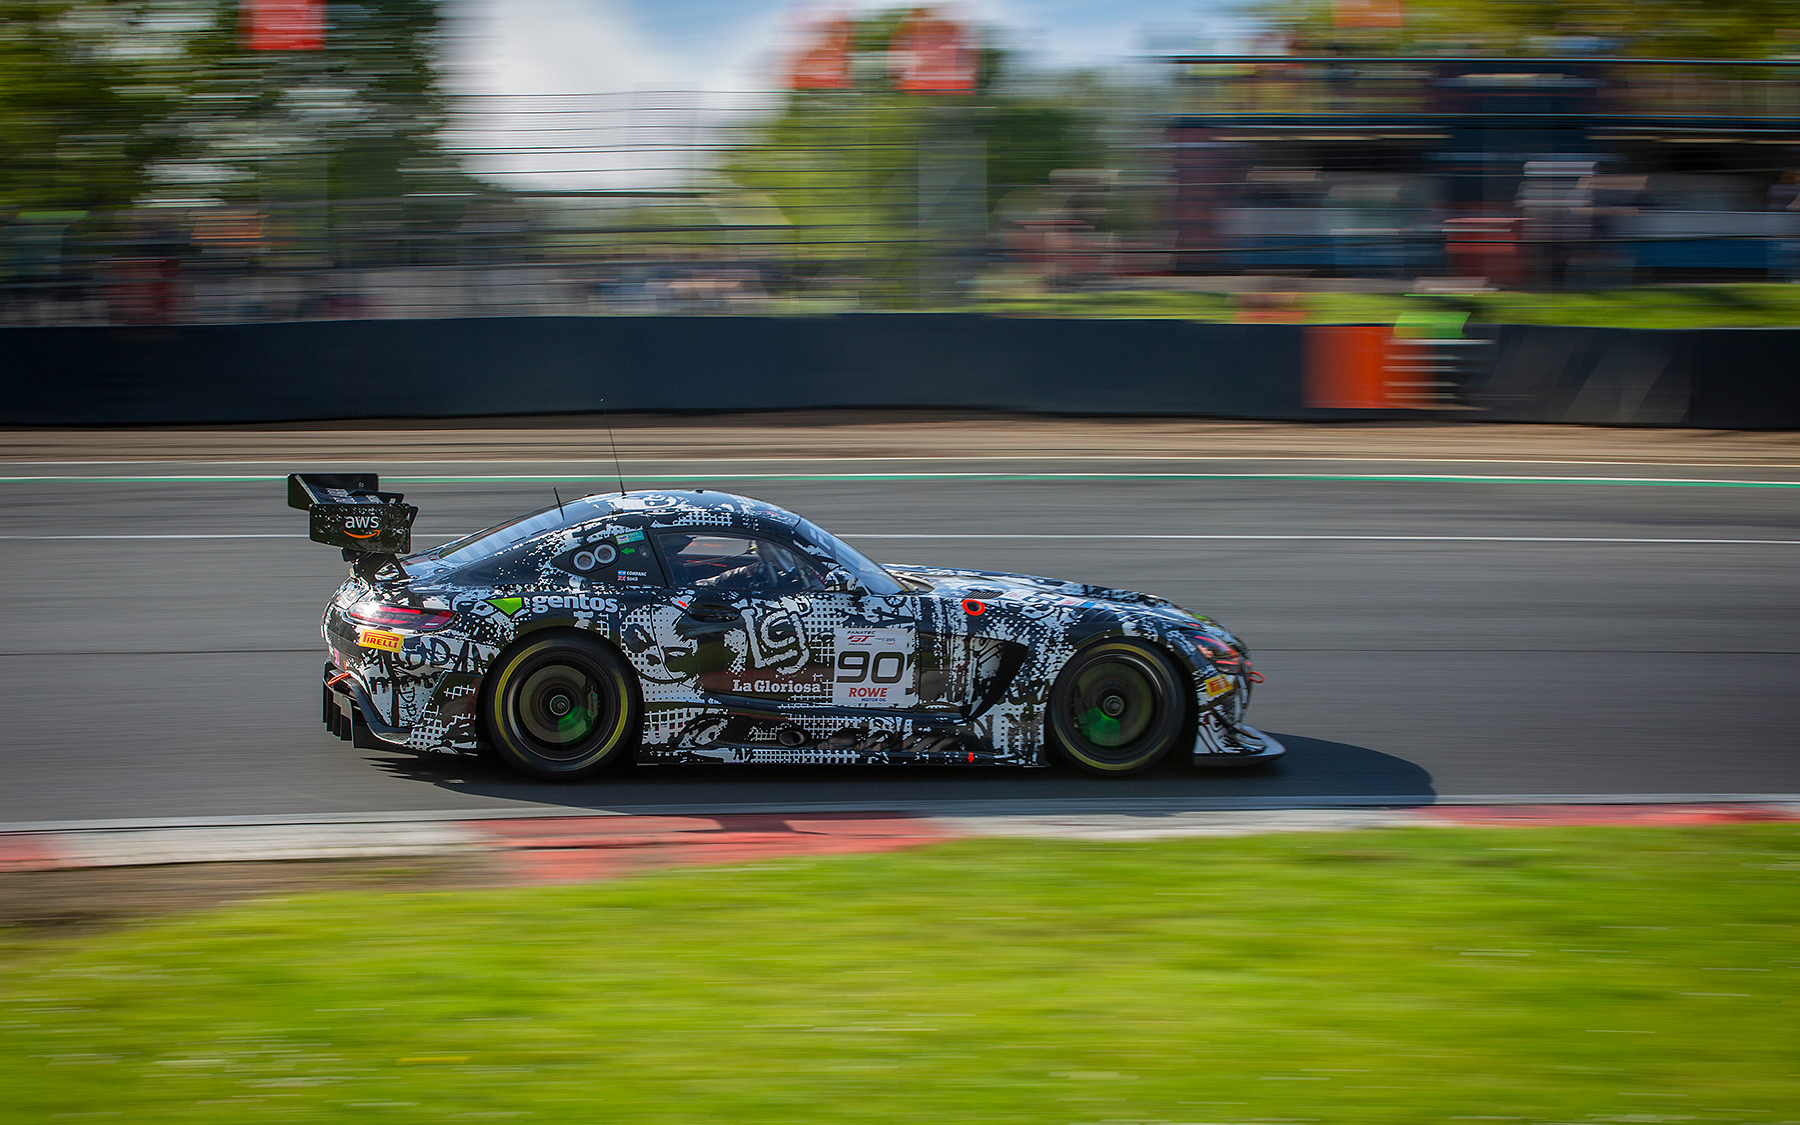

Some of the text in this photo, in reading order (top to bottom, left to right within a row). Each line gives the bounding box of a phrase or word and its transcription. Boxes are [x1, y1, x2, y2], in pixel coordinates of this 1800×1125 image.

[345, 516, 380, 529] aws
[531, 593, 619, 614] gentos
[362, 631, 400, 649] PIRELLI
[847, 635, 876, 643] GT
[836, 650, 906, 684] 90
[732, 679, 821, 693] La Gloriosa
[848, 687, 888, 698] ROWE
